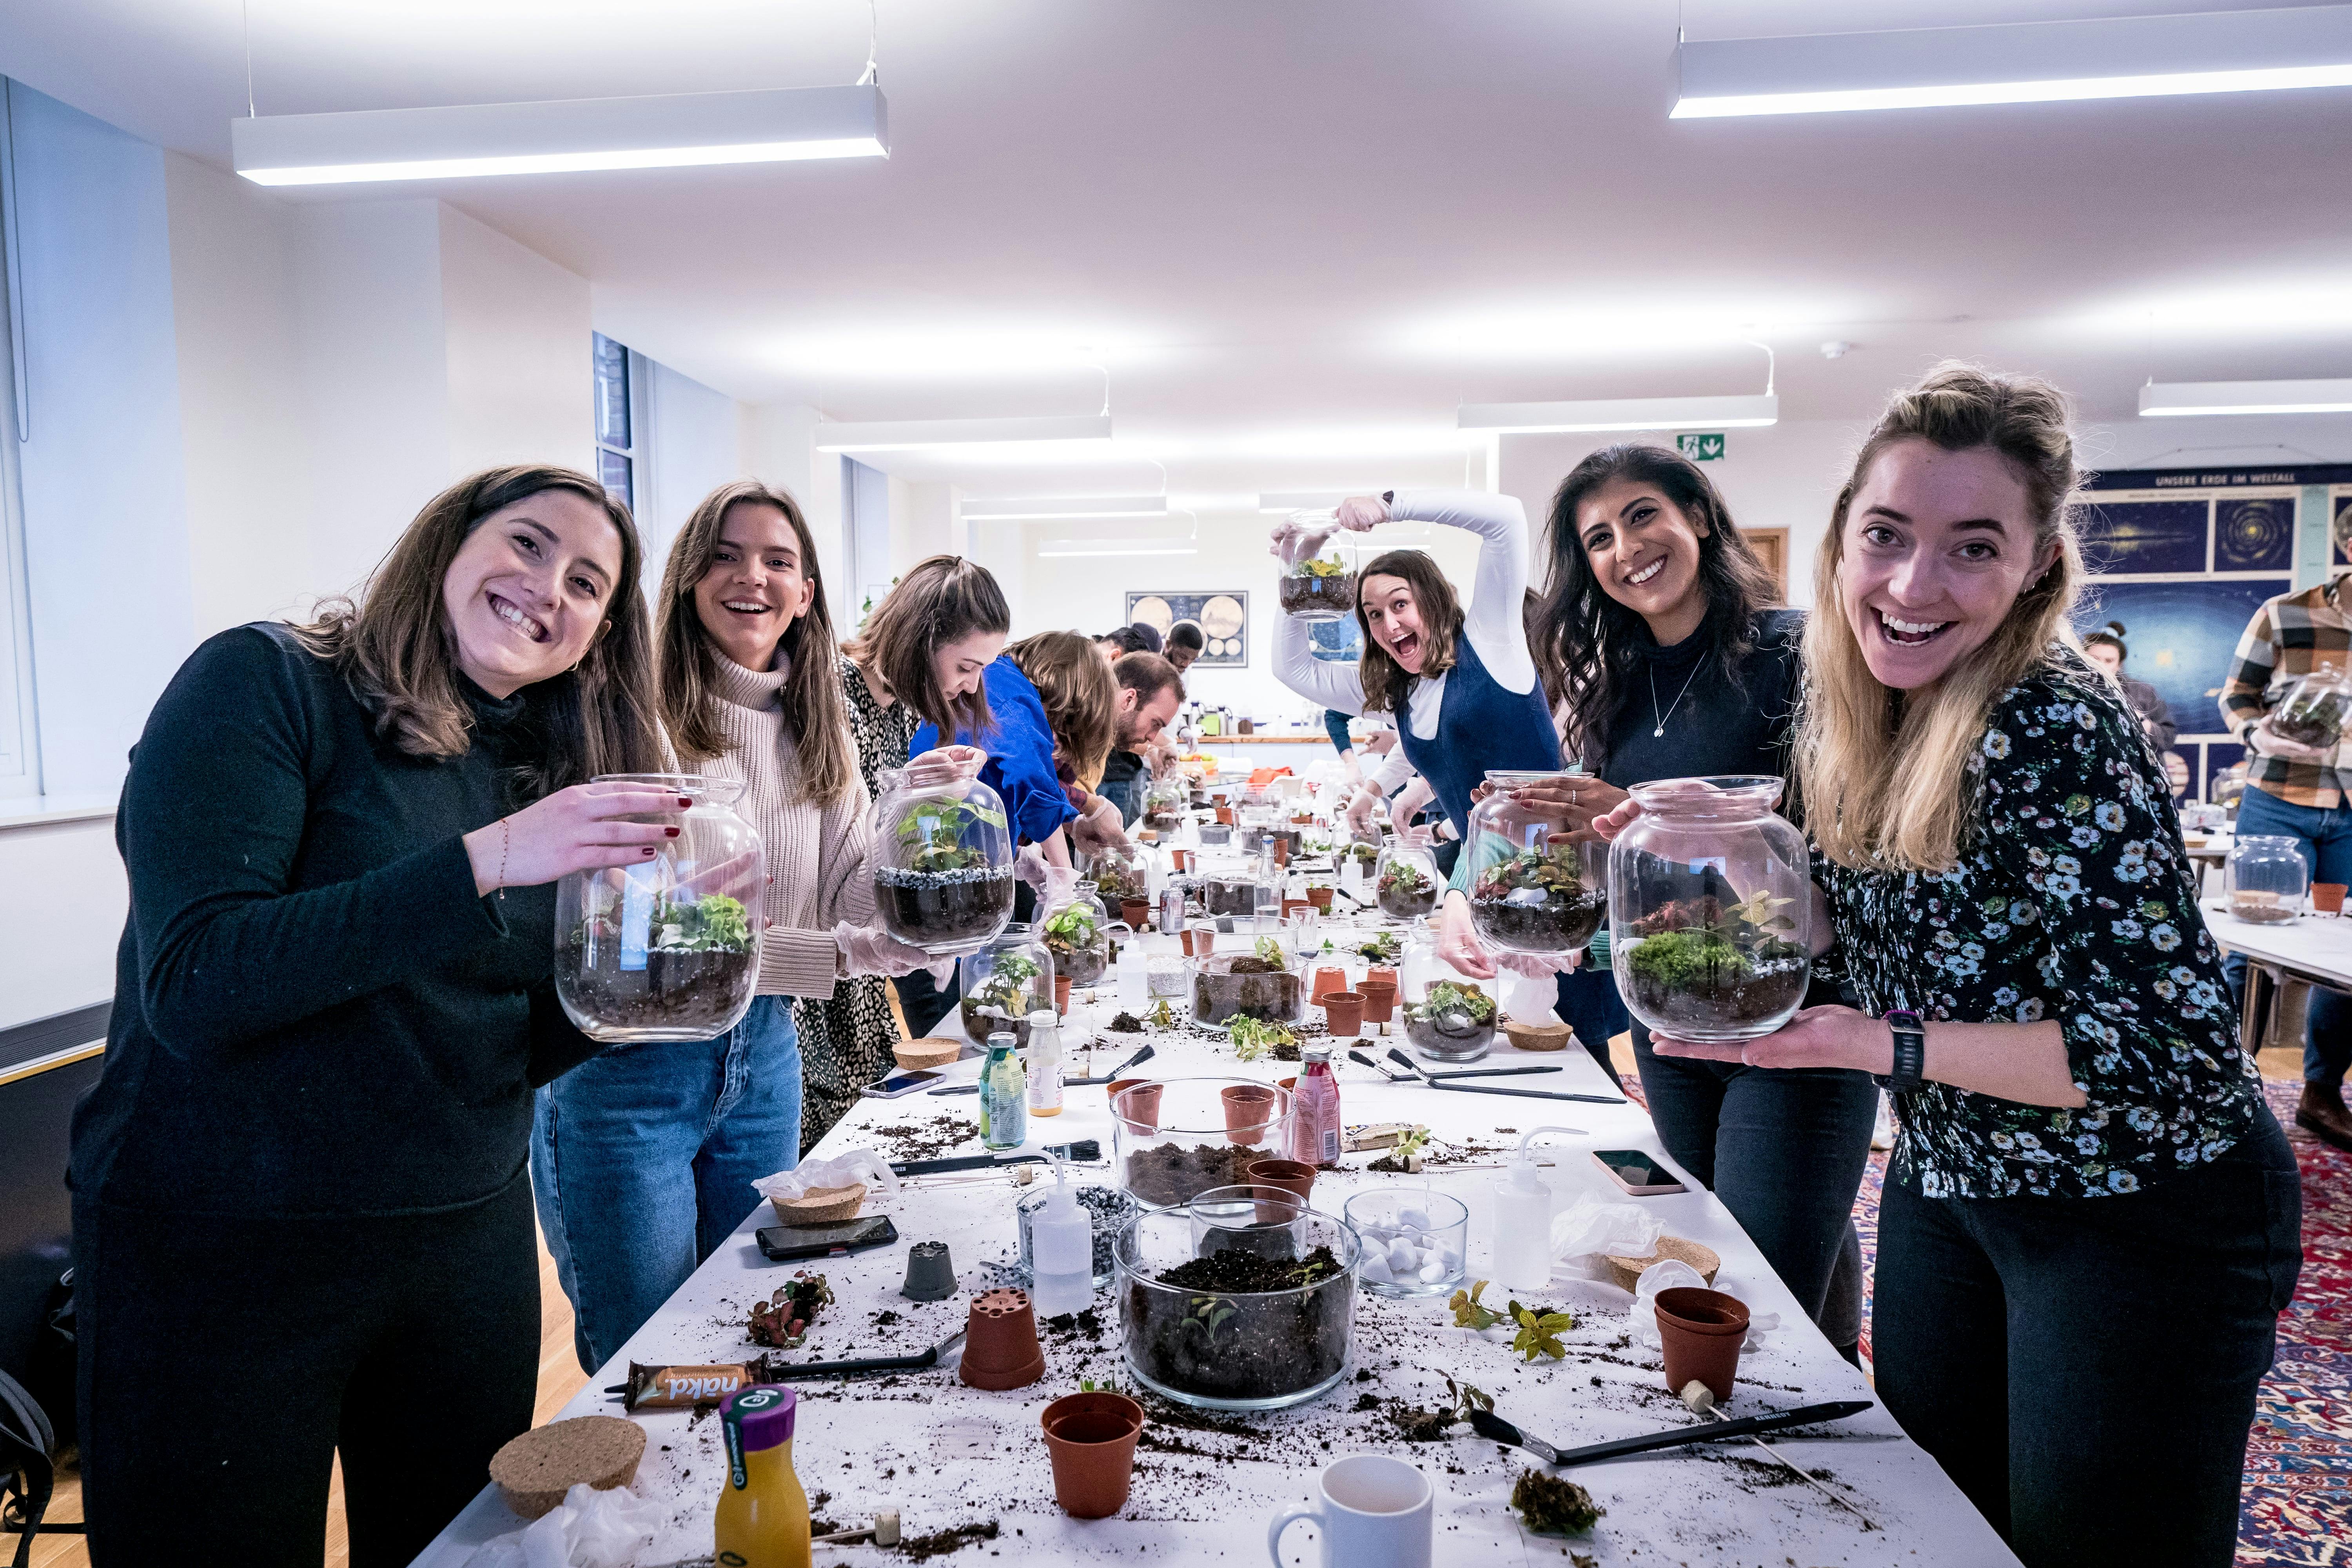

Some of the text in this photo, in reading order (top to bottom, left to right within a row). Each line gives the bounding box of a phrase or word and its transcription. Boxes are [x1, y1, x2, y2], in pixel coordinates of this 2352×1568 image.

[2156, 473, 2295, 486] UNSERE ERDE IM WELTALL
[1754, 1412, 1791, 1421] KENNEDY
